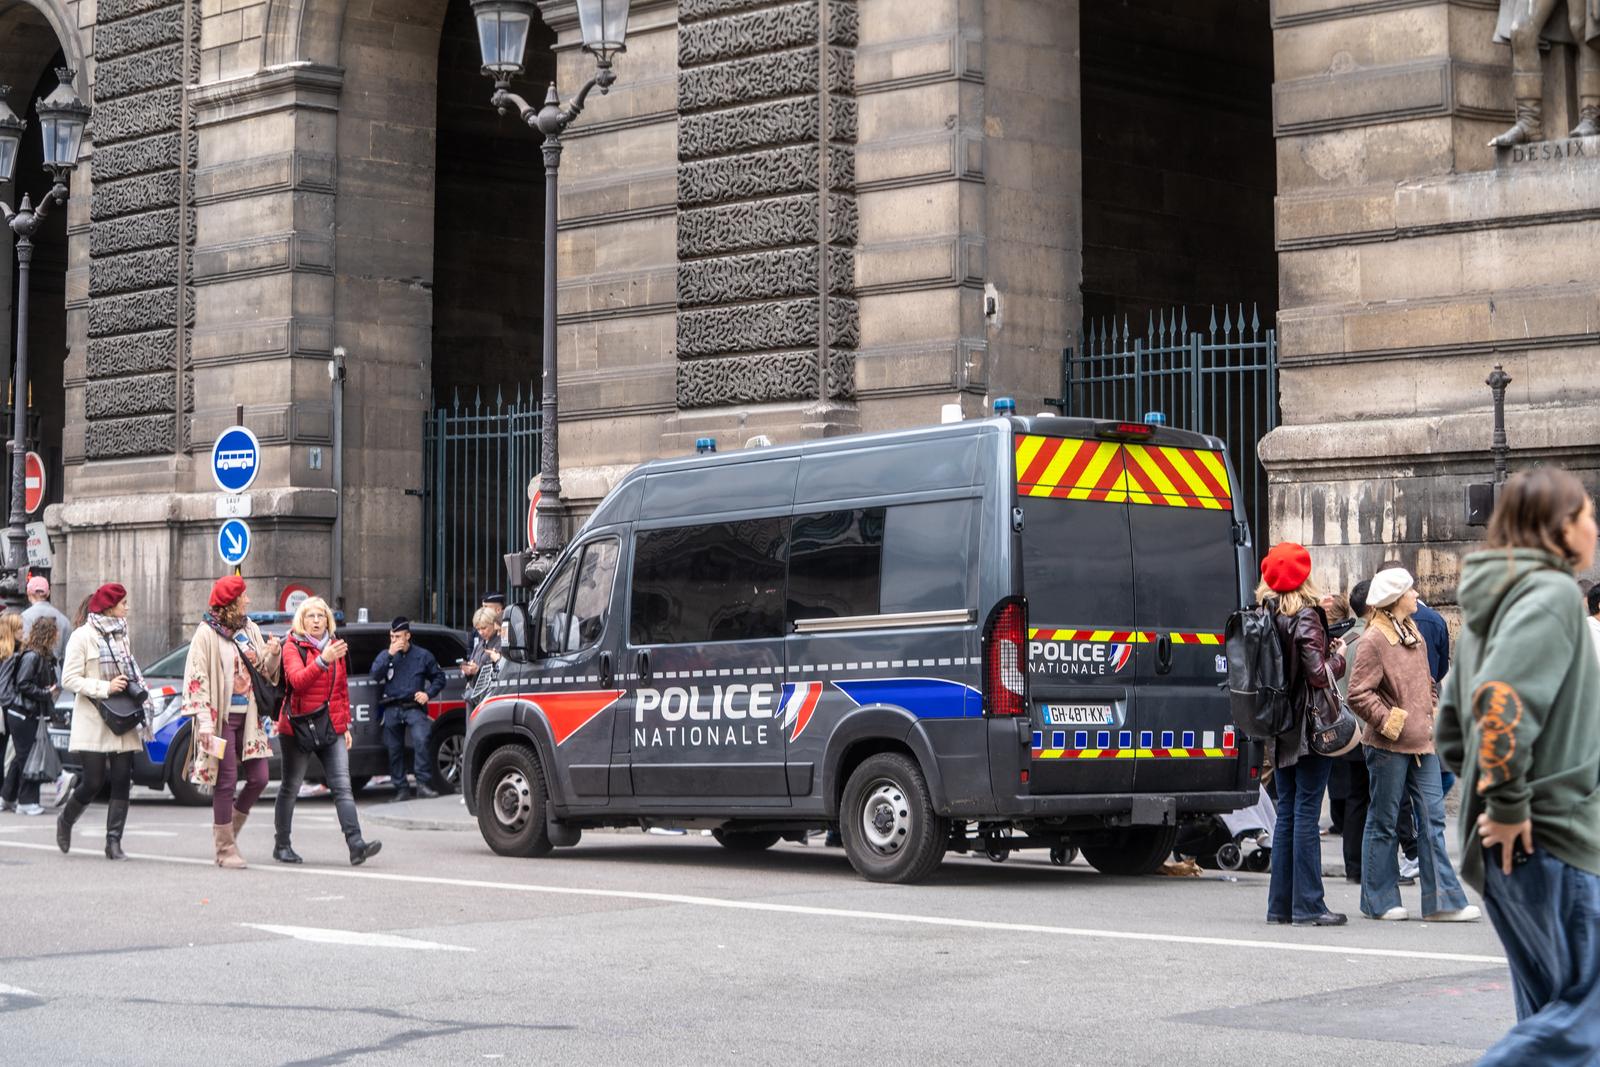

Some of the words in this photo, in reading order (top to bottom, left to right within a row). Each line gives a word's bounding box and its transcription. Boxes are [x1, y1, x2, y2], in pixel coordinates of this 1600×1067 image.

[1512, 141, 1585, 163] DESAIX
[1028, 641, 1106, 662] POLICE
[1028, 662, 1105, 675] NATIONALE
[635, 683, 774, 723] POLICE
[634, 725, 768, 747] NATIONALE
